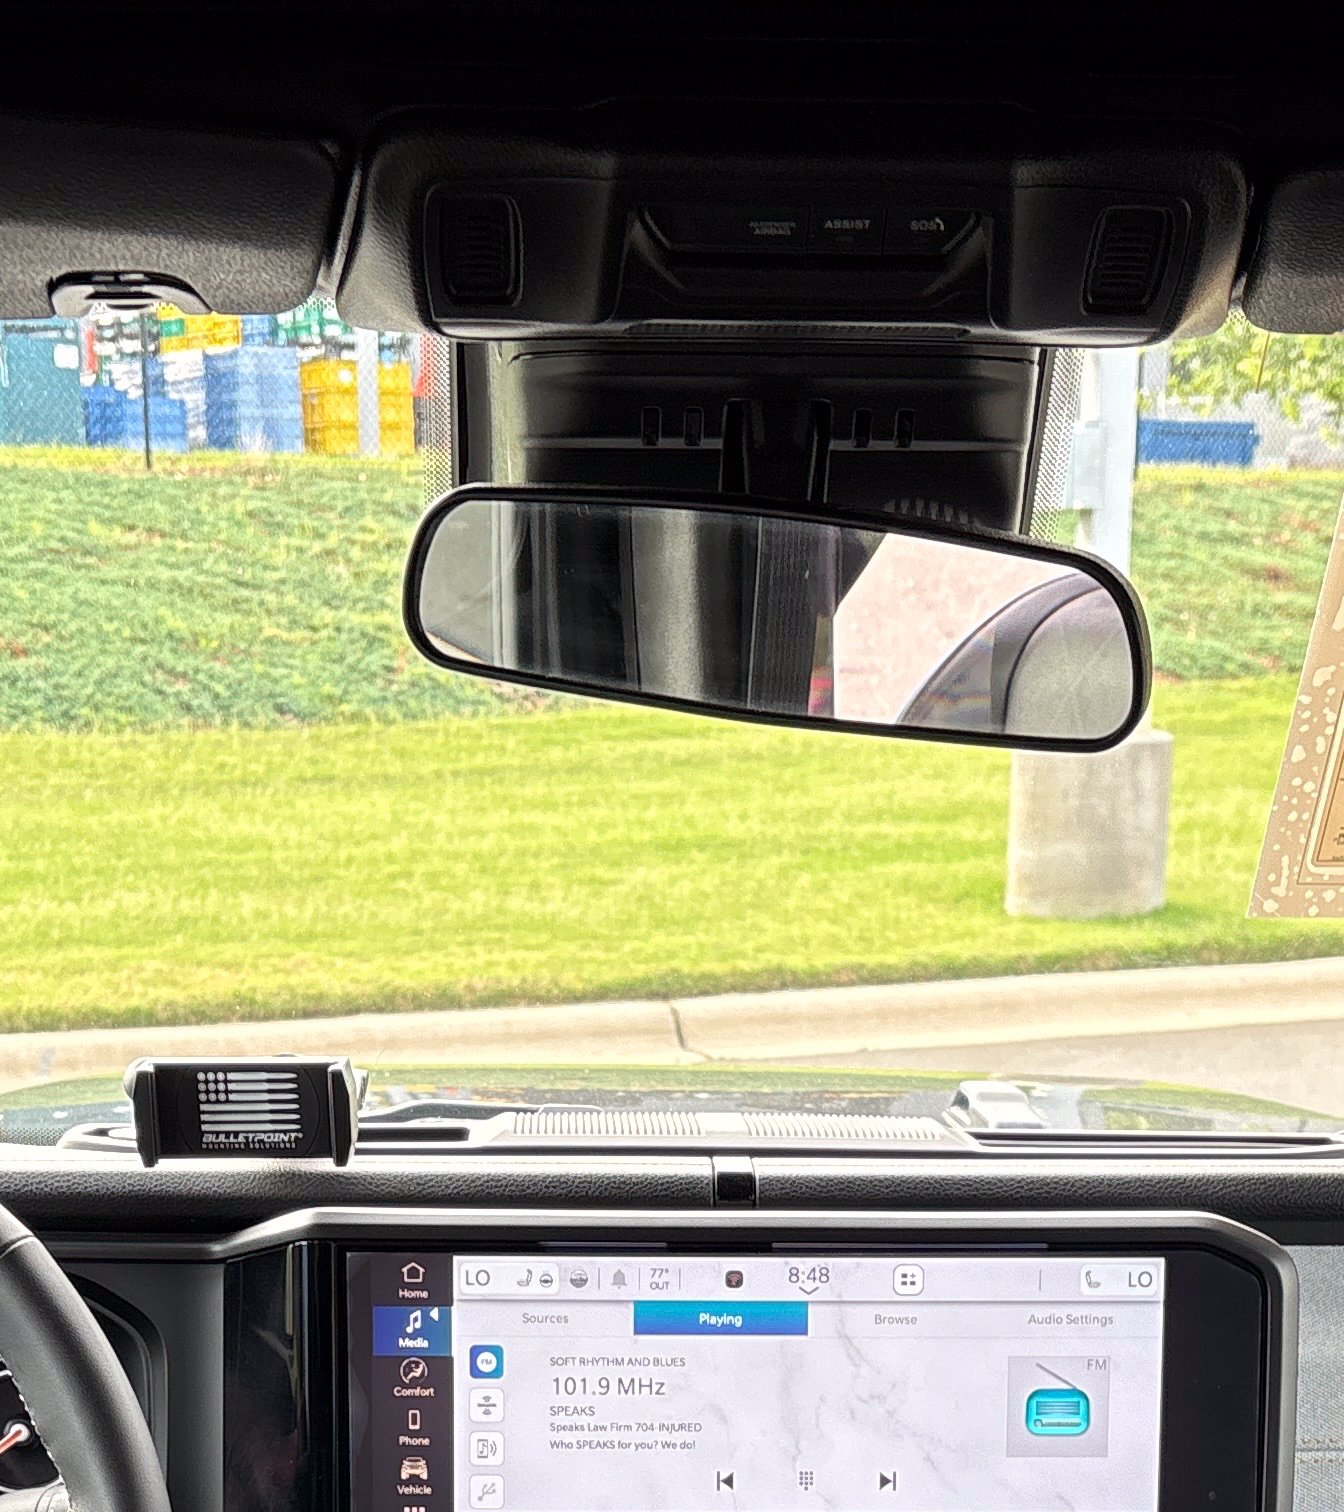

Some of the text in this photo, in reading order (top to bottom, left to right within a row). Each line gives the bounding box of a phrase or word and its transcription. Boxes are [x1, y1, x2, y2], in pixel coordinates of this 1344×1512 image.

[824, 220, 871, 229] ASSIST
[910, 220, 936, 231] SOS
[465, 1270, 491, 1287] LO
[650, 1267, 670, 1279] 77°
[788, 1267, 830, 1283] 8:48
[1128, 1271, 1153, 1288] LO
[650, 1281, 670, 1292] OUT
[399, 1288, 429, 1300] Home
[522, 1312, 569, 1325] Sources
[699, 1312, 743, 1328] Playing
[874, 1313, 918, 1326] Browse
[1028, 1313, 1114, 1327] Audio Settings
[399, 1338, 429, 1349] Media
[550, 1357, 686, 1367] SOFT RHYTHM AND BLUES
[1086, 1359, 1107, 1371] FM
[394, 1386, 435, 1398] Comfort
[552, 1377, 666, 1397] 101.9 MHz
[550, 1406, 596, 1417] SPEAKS
[550, 1421, 703, 1434] Speaks Law Firm 704-INJURED
[399, 1435, 430, 1446] Phone
[550, 1439, 696, 1453] Who SPEAKS for you? We do!
[397, 1483, 432, 1496] Vehicle
